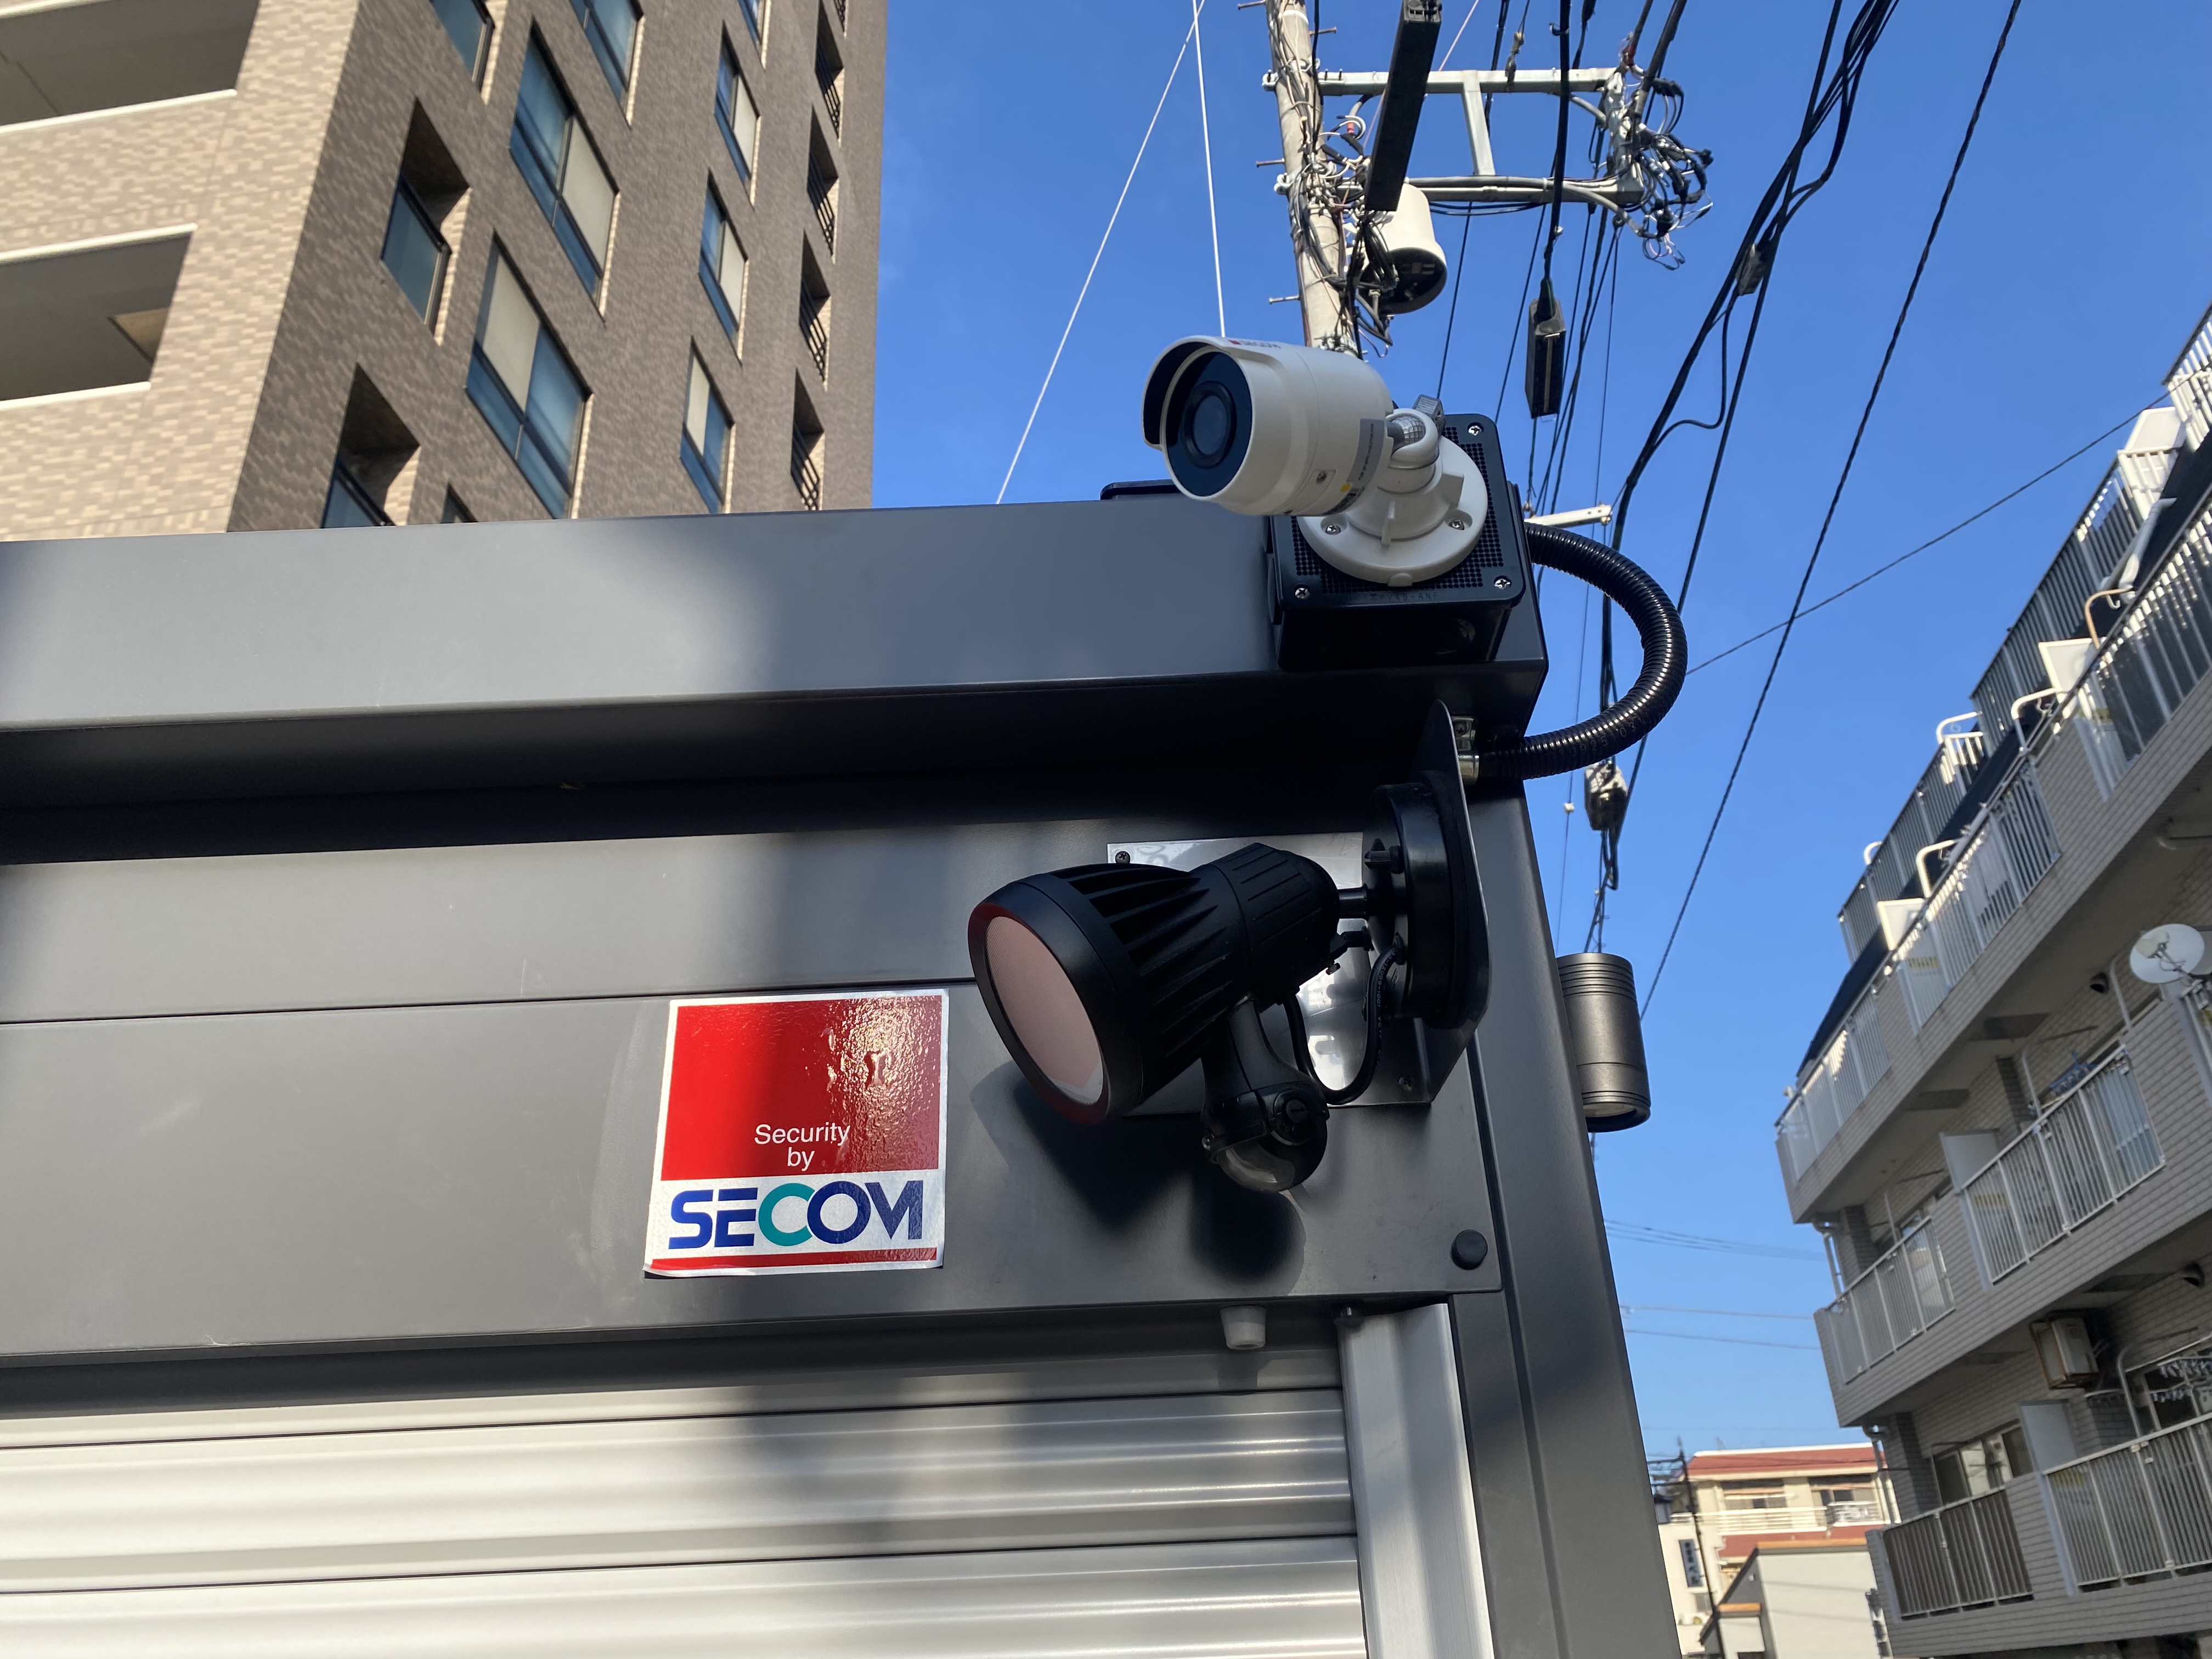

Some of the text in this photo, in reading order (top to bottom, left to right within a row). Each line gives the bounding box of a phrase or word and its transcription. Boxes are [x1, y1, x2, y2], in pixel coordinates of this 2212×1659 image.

[754, 1121, 851, 1147] Security
[787, 1147, 815, 1172] by
[668, 1180, 924, 1250] SECOM
